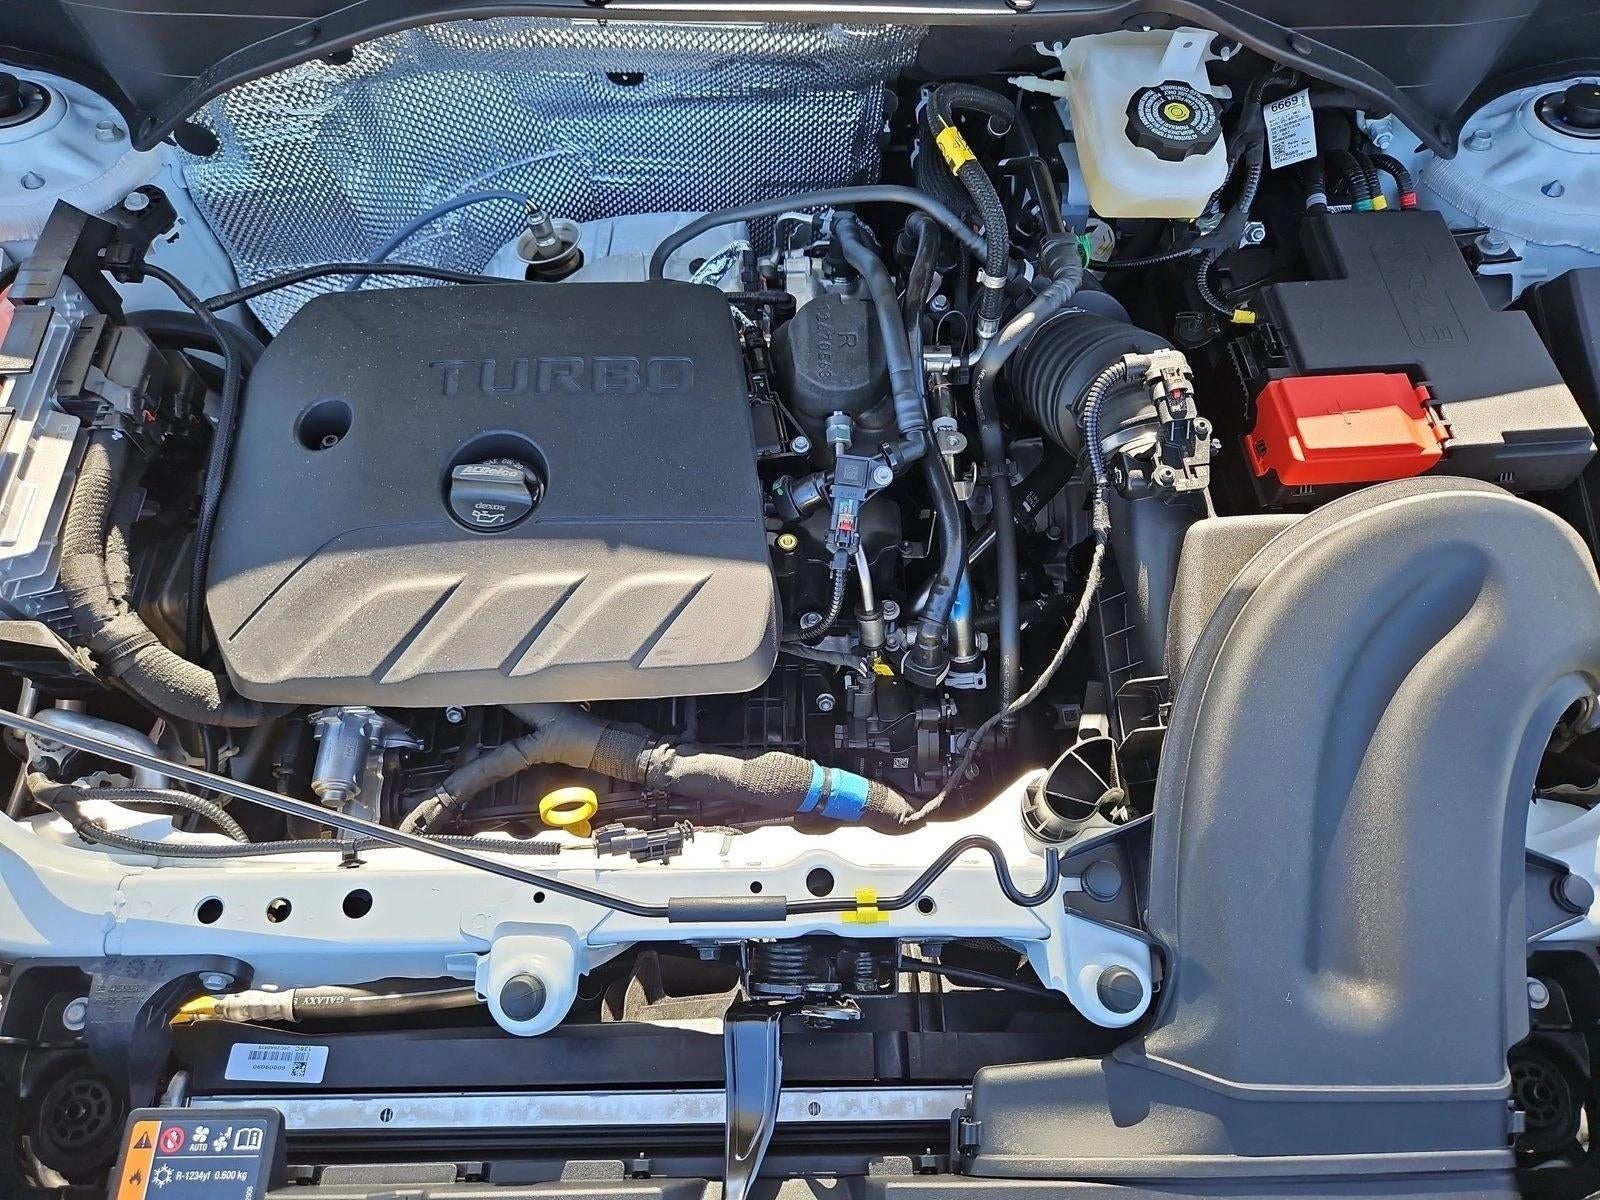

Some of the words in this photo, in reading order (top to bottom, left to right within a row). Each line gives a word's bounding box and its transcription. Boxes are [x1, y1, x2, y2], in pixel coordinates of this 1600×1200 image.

[1271, 96, 1299, 112] 6669
[838, 332, 859, 348] R
[428, 356, 694, 396] TURBO
[460, 466, 519, 477] ACDelco
[474, 502, 507, 511] dexos
[302, 995, 344, 1005] GALAXY
[189, 1143, 208, 1152] AUTO
[176, 1170, 212, 1182] R-1234yf
[214, 1170, 236, 1180] 0.600
[237, 1170, 248, 1182] kg
